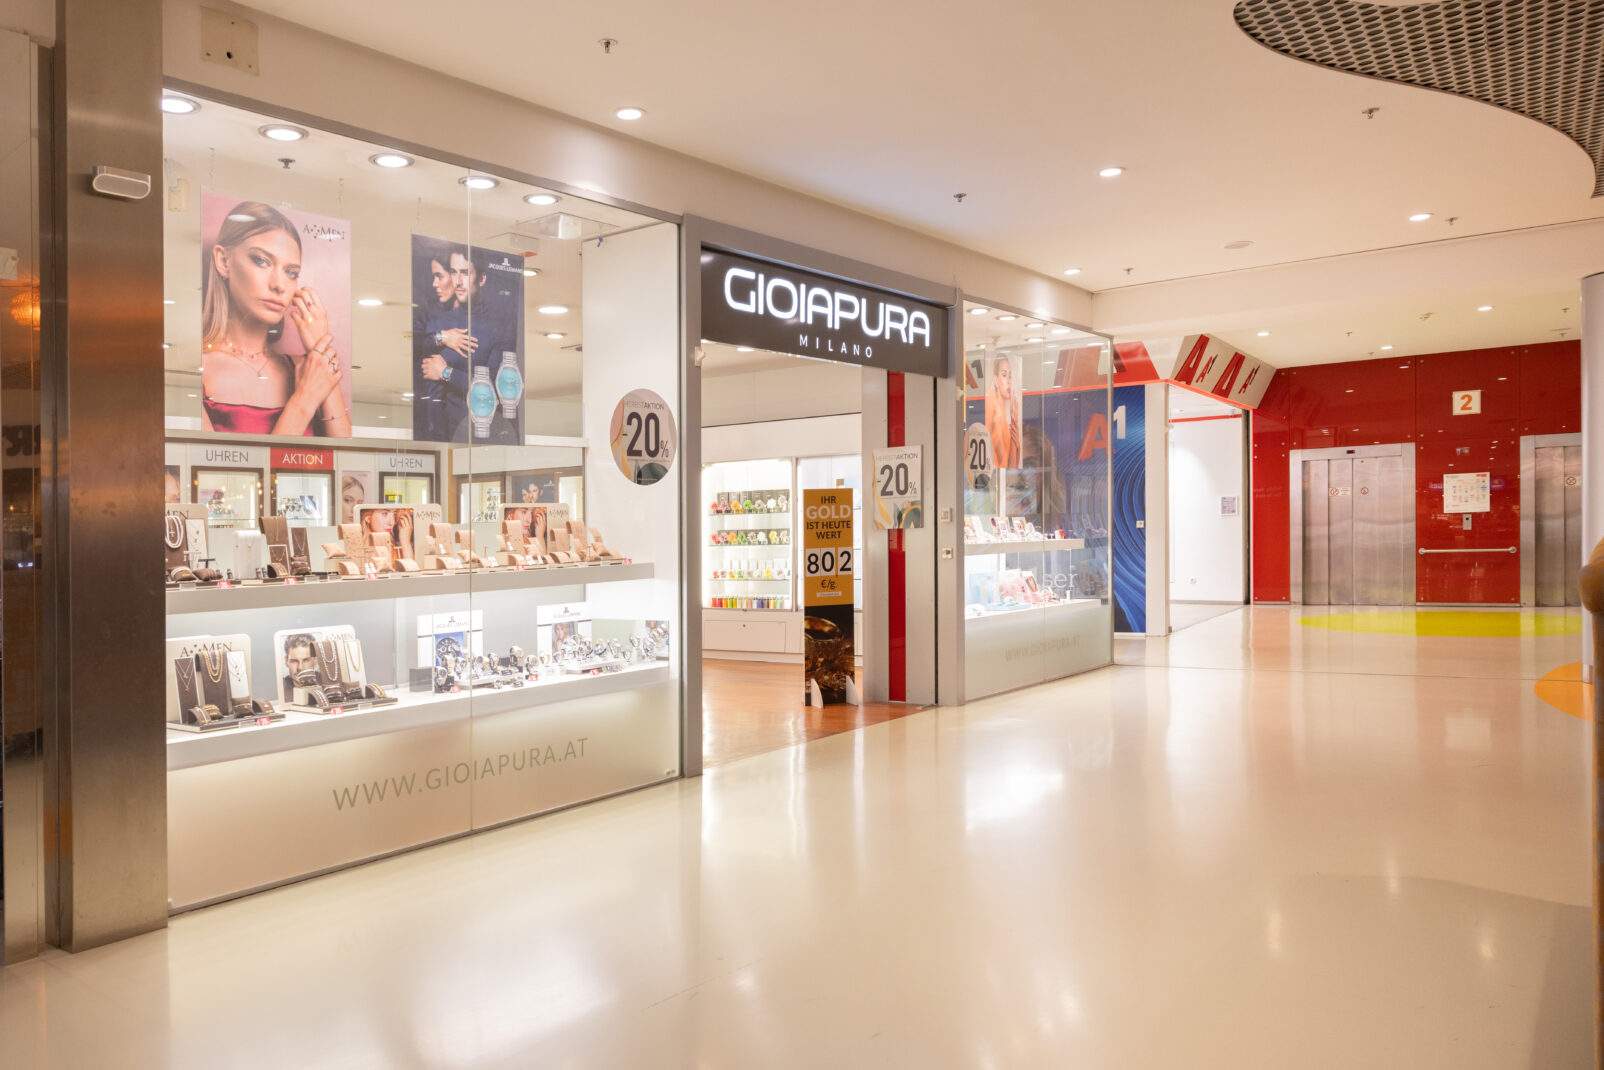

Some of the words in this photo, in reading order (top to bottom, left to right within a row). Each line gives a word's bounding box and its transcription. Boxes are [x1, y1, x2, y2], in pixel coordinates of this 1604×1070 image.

[724, 267, 931, 347] GIOIAPURA
[799, 334, 873, 358] MILANO
[1460, 394, 1473, 411] 2
[1078, 405, 1126, 463] A1
[206, 449, 249, 463] UHREN
[282, 452, 323, 465] AKTION
[390, 456, 423, 469] UHREN
[821, 495, 837, 504] IHR
[806, 504, 851, 519] GOLD
[806, 521, 820, 529] IST
[822, 520, 851, 528] HEUTE
[816, 530, 842, 539] WERT
[332, 737, 588, 811] WWW.GIOIAPURA.AT
